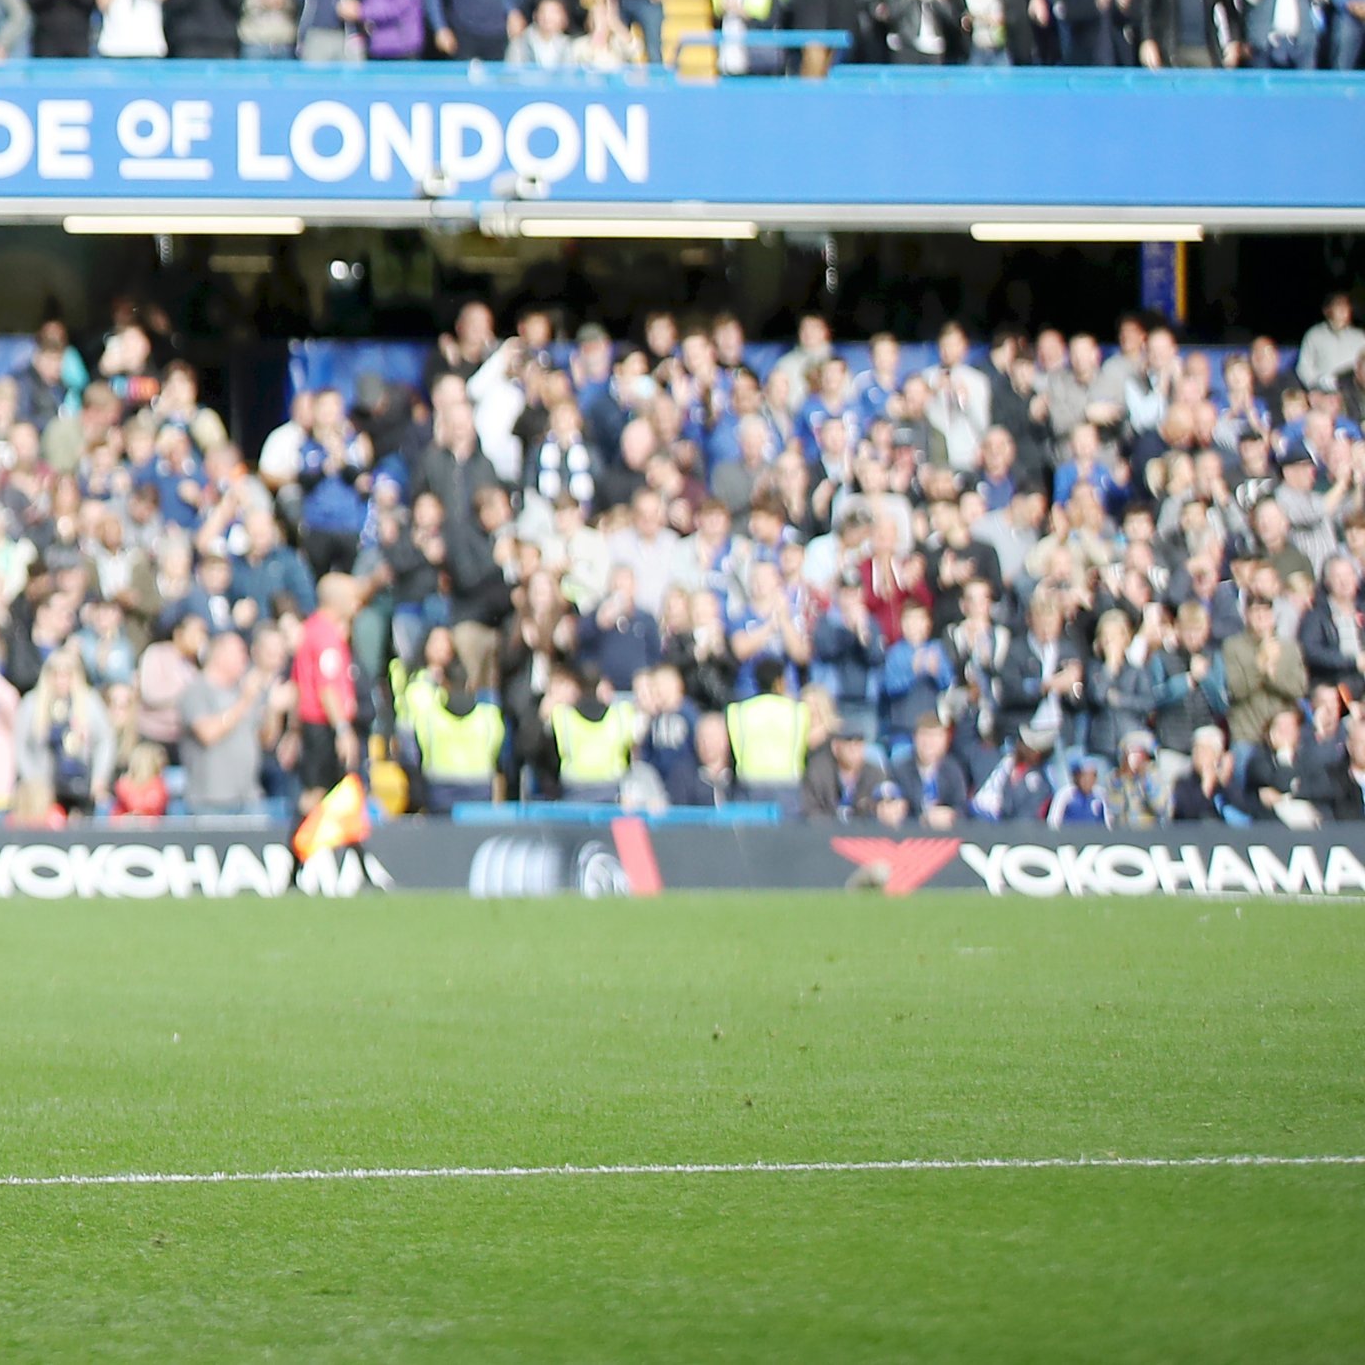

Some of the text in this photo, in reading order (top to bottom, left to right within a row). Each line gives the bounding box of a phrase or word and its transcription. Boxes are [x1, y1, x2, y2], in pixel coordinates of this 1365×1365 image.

[116, 98, 213, 160] OF
[236, 100, 648, 184] LONDON
[958, 842, 1365, 898] YOKOHAMA
